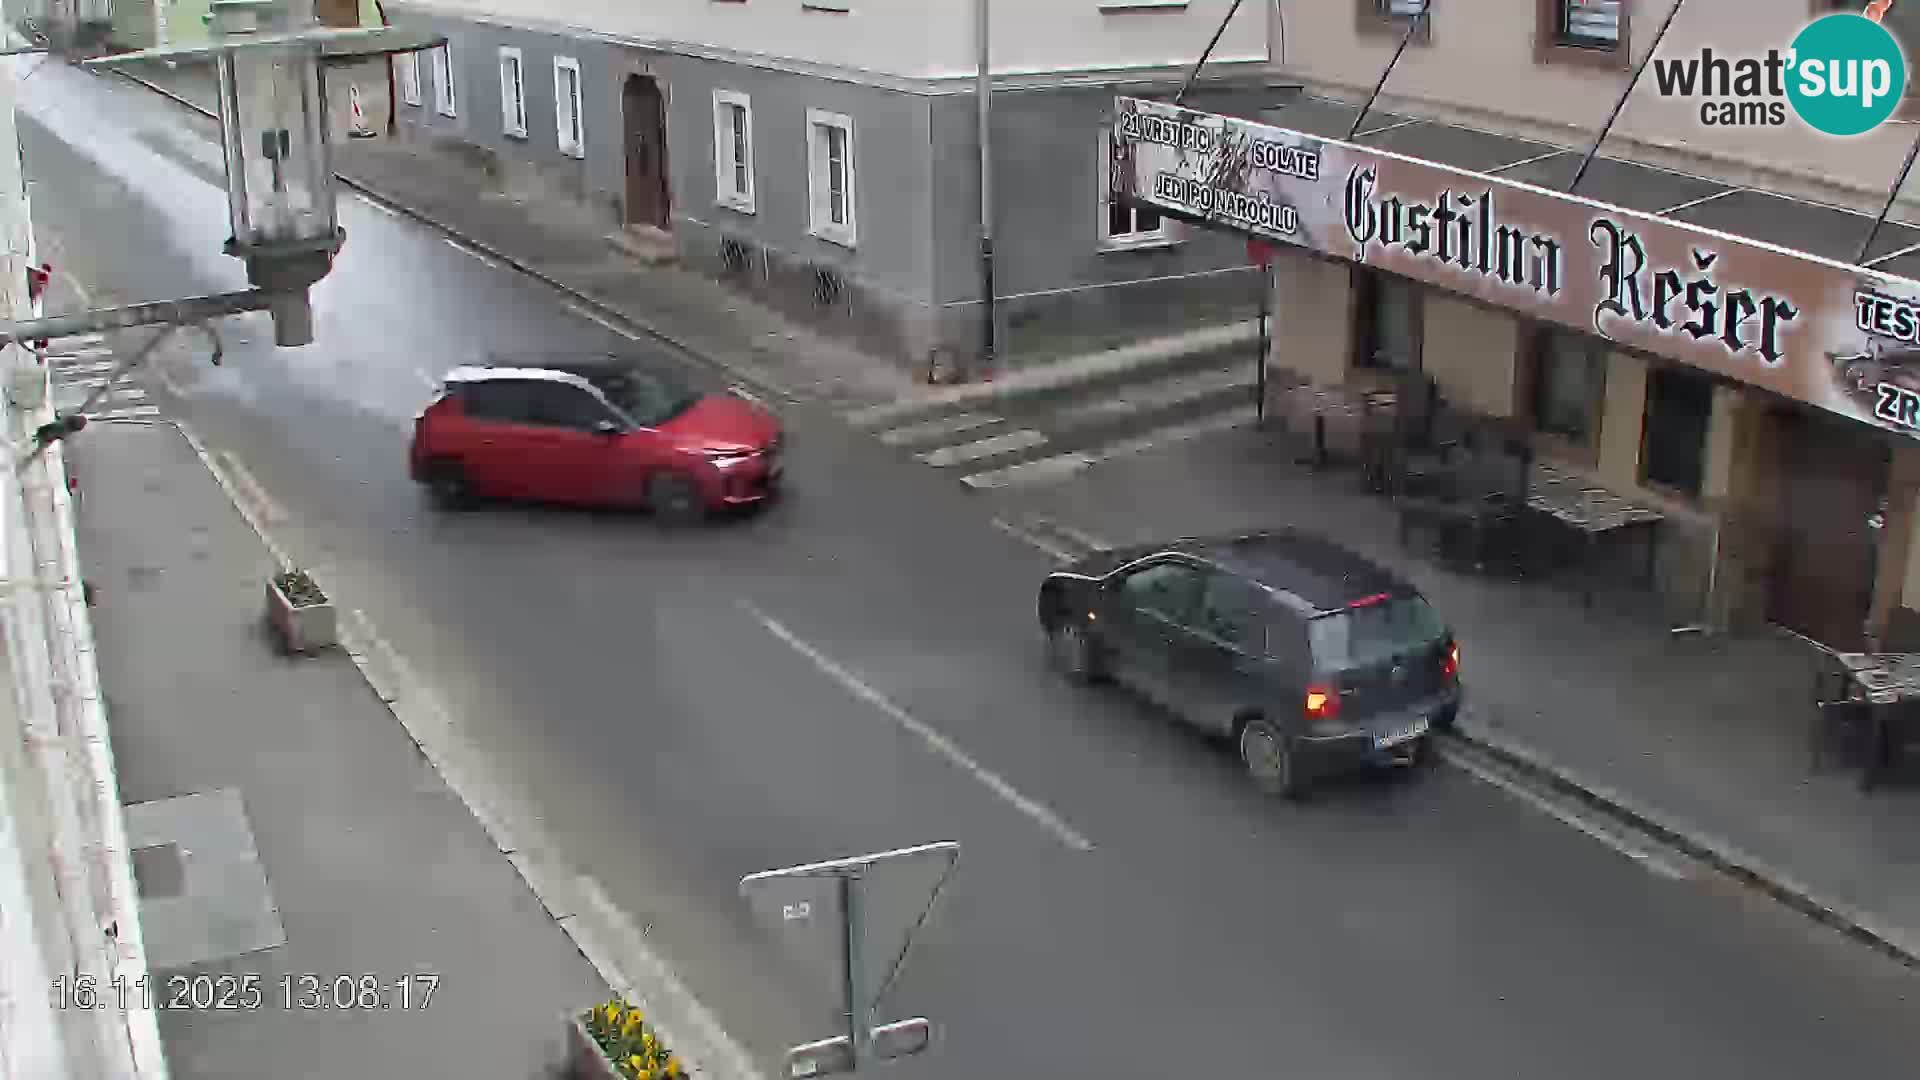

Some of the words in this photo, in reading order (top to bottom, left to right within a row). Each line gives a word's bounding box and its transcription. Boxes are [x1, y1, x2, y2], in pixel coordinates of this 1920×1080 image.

[1122, 113, 1139, 133] 21
[1143, 118, 1180, 145] VRST
[1254, 143, 1318, 178] SOLATE
[1157, 176, 1187, 200] JEDI
[1190, 184, 1211, 209] PO
[1590, 219, 1798, 363] Rešer
